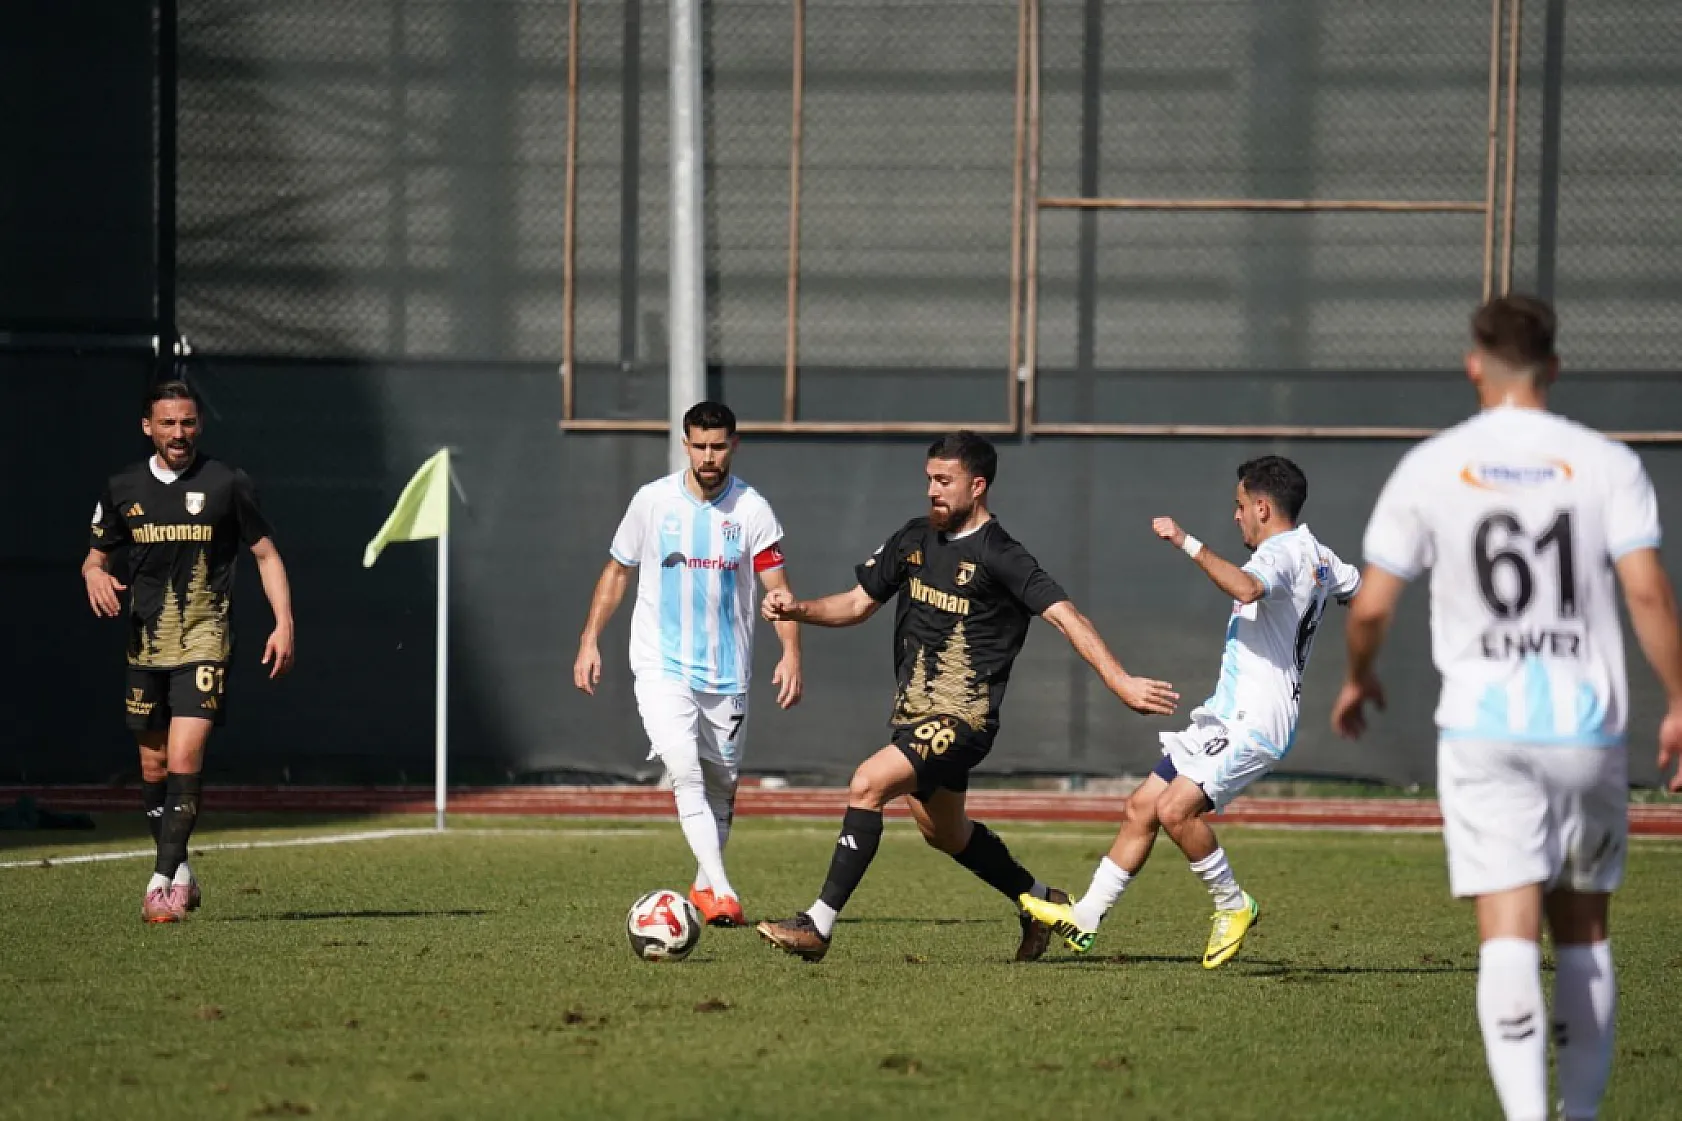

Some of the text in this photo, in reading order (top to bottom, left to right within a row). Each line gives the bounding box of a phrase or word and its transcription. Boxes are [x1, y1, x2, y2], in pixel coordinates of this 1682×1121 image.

[132, 523, 213, 543] mikroman
[1473, 507, 1576, 619] 61
[195, 665, 225, 694] 61
[728, 715, 744, 741] 7
[914, 720, 957, 756] 66
